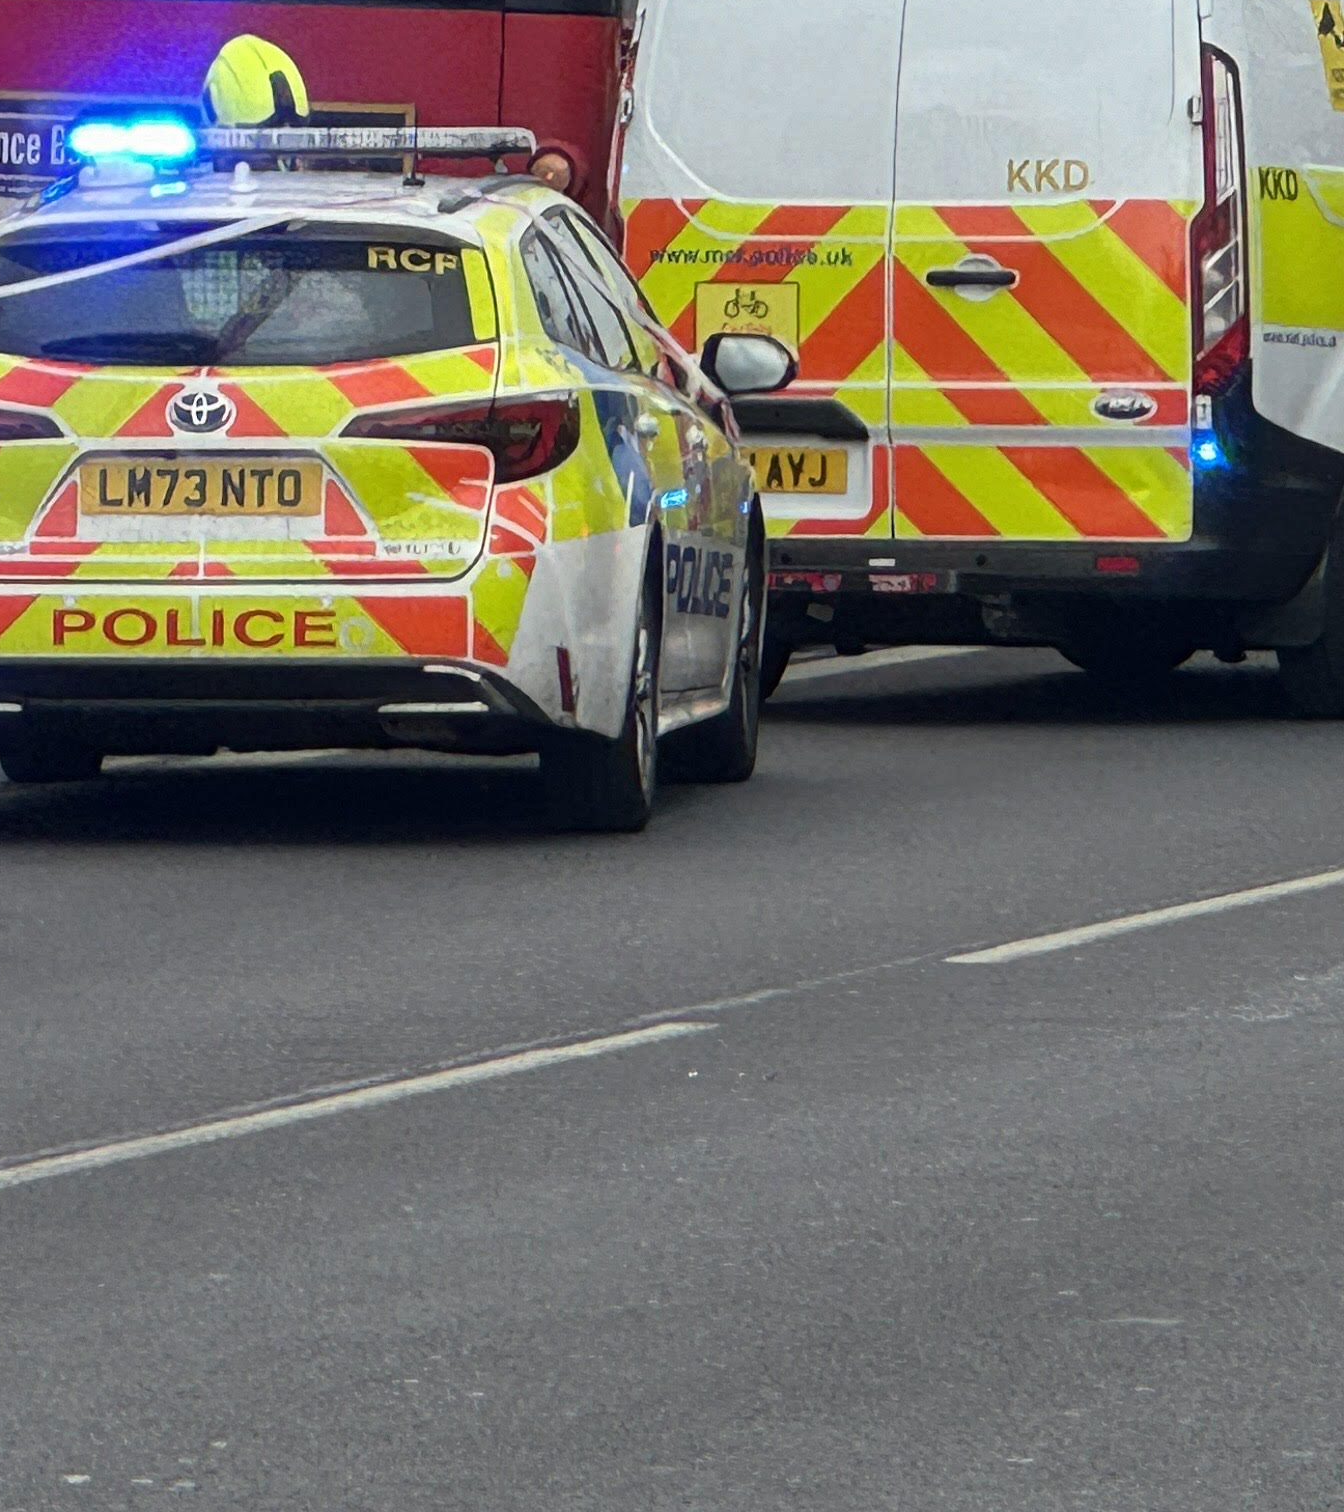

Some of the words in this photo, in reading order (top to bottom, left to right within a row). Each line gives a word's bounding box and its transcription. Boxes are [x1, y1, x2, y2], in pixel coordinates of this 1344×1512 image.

[1006, 159, 1091, 194] KKD
[1258, 167, 1299, 201] KKD
[97, 465, 207, 507] LM73
[219, 465, 302, 506] NTO
[667, 543, 733, 619] POLICE
[52, 608, 337, 648] POLICE
